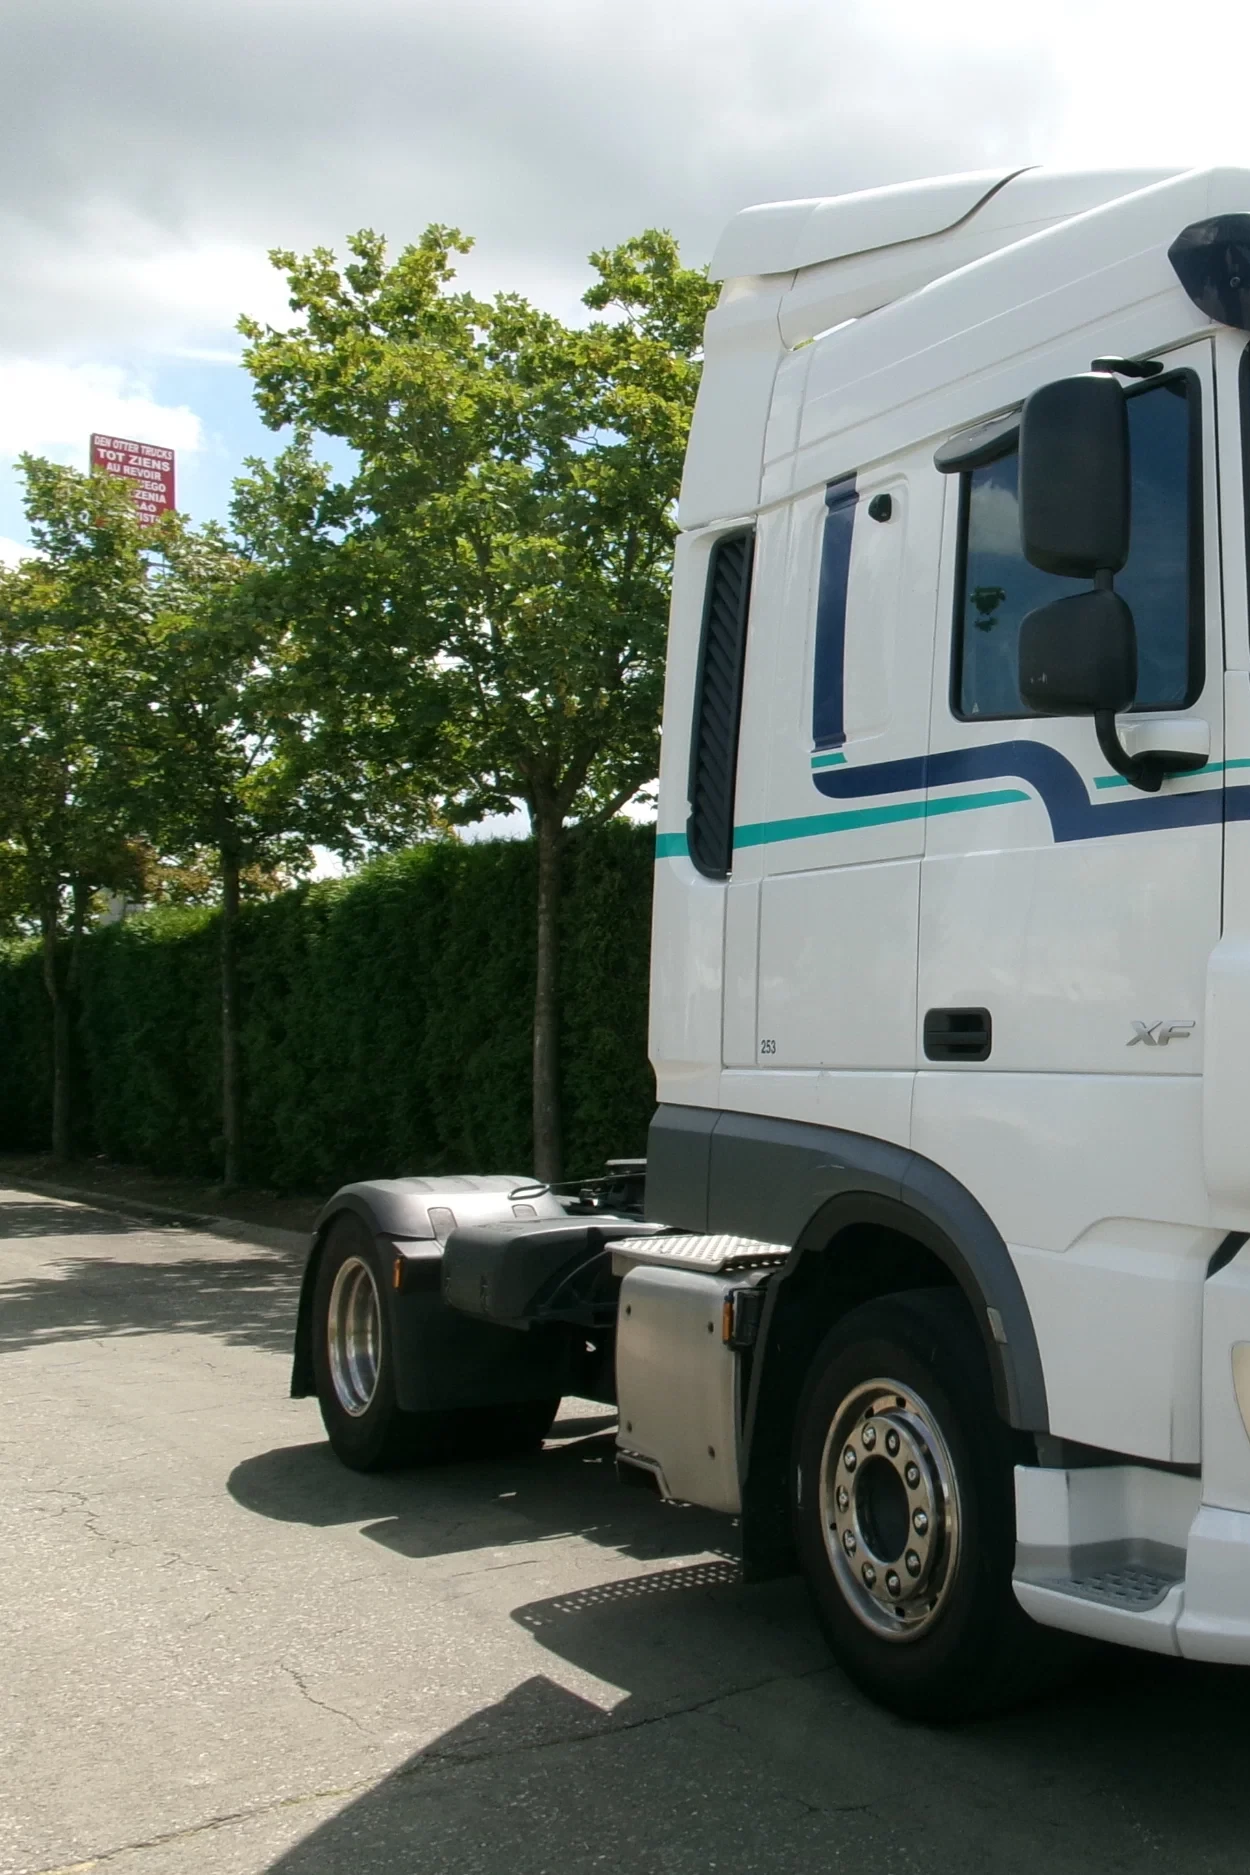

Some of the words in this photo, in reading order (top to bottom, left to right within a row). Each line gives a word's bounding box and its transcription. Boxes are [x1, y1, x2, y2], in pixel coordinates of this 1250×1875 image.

[94, 435, 112, 447] DEN
[113, 439, 139, 454] OTTER
[141, 445, 173, 461] TRUCKS
[97, 448, 126, 462] TOT
[128, 455, 171, 472] ZIENS
[106, 462, 121, 473] AU
[123, 466, 162, 481] REVOIR
[1126, 1020, 1196, 1047] XF
[761, 1040, 776, 1054] 253
